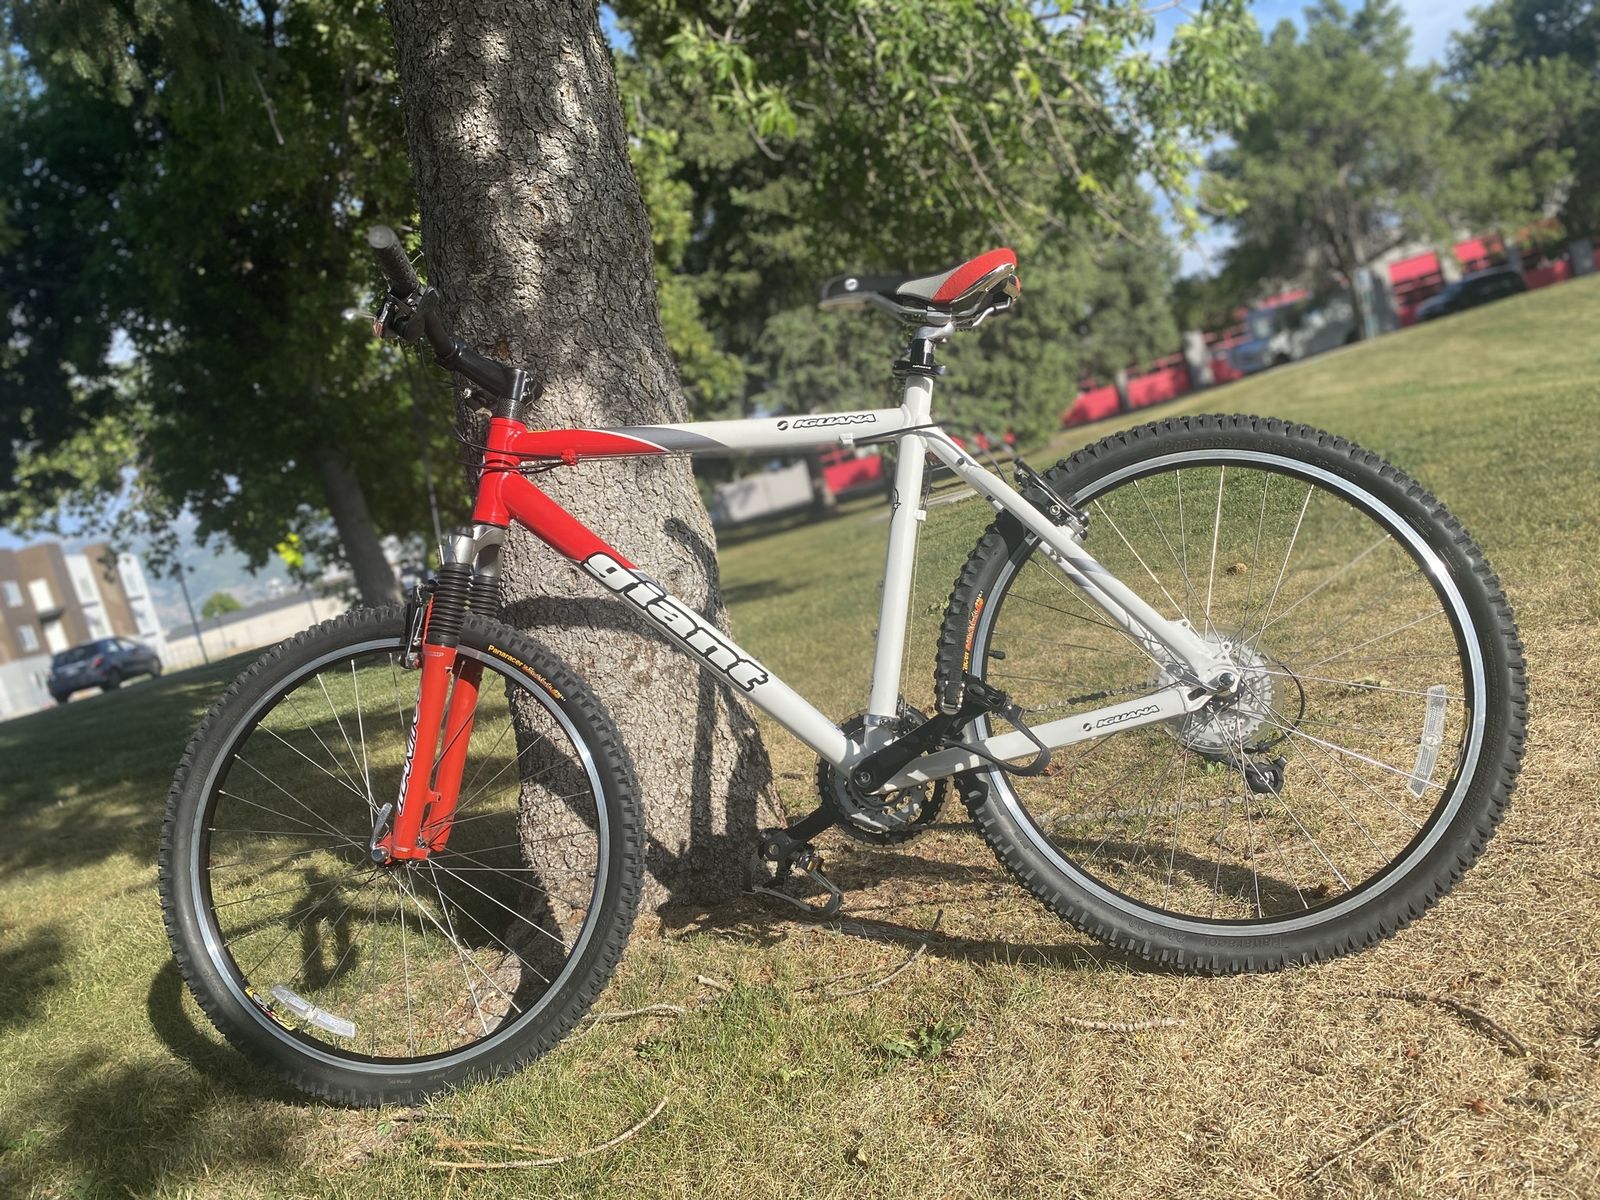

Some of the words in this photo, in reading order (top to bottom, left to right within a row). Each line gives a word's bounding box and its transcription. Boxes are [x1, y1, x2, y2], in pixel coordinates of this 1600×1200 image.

[793, 414, 877, 429] IGUANA
[580, 552, 769, 692] giant
[487, 644, 523, 667] Panaracer
[1096, 705, 1160, 728] IGUANA
